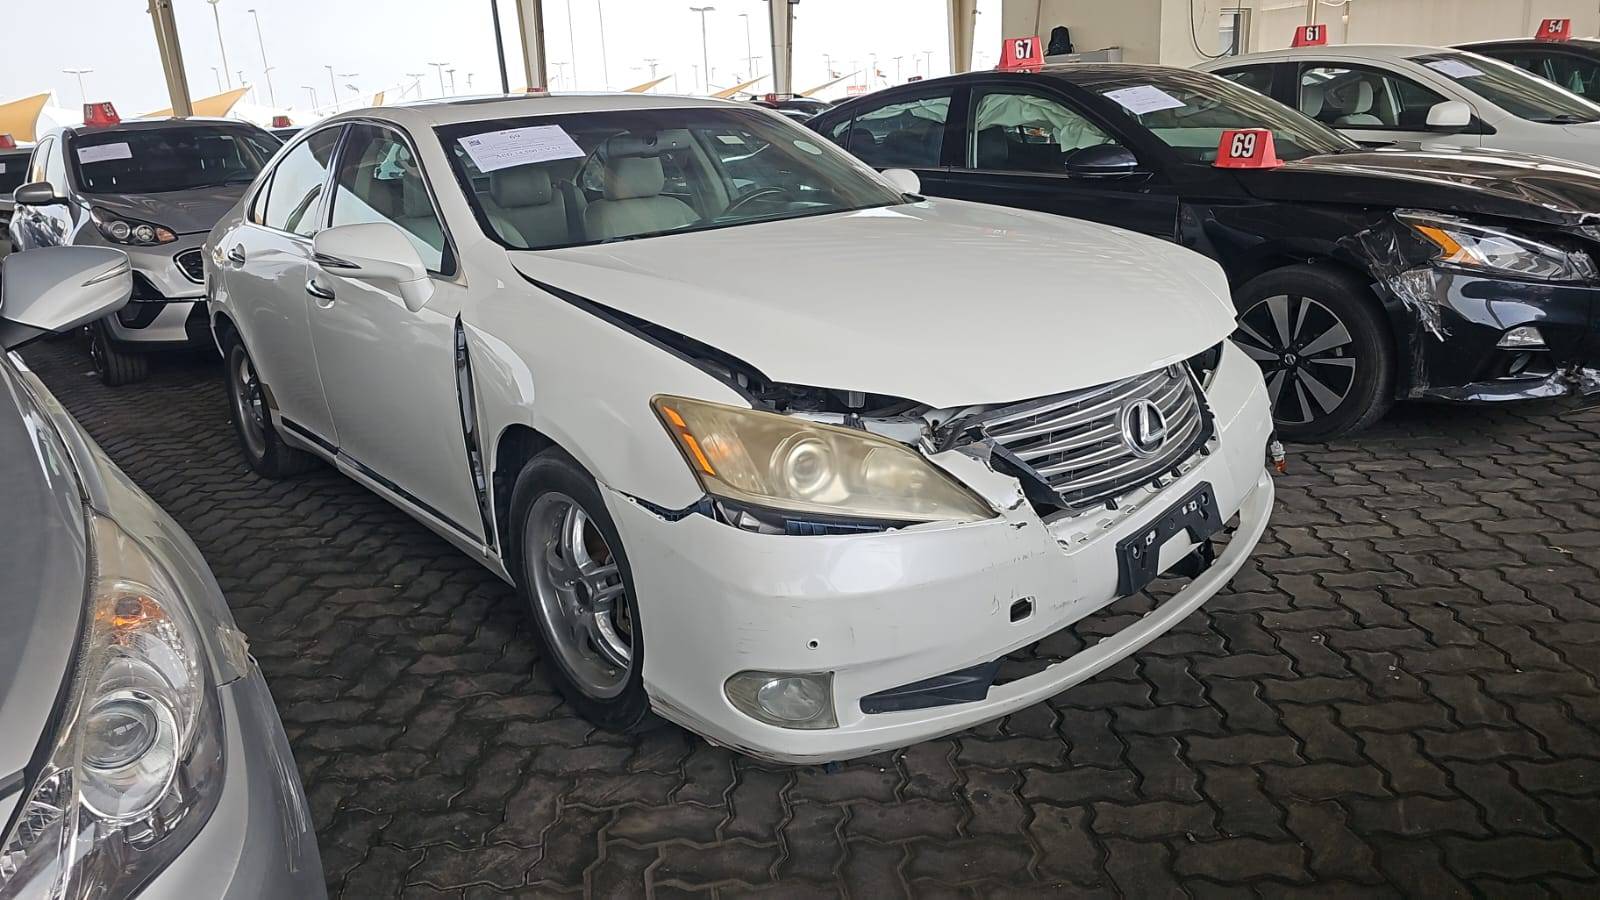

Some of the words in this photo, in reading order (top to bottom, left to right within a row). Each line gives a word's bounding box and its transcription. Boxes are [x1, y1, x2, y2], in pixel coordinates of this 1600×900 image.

[1306, 26, 1319, 41] 61
[1549, 20, 1563, 33] 54
[1015, 39, 1032, 59] 67
[1230, 133, 1256, 158] 69
